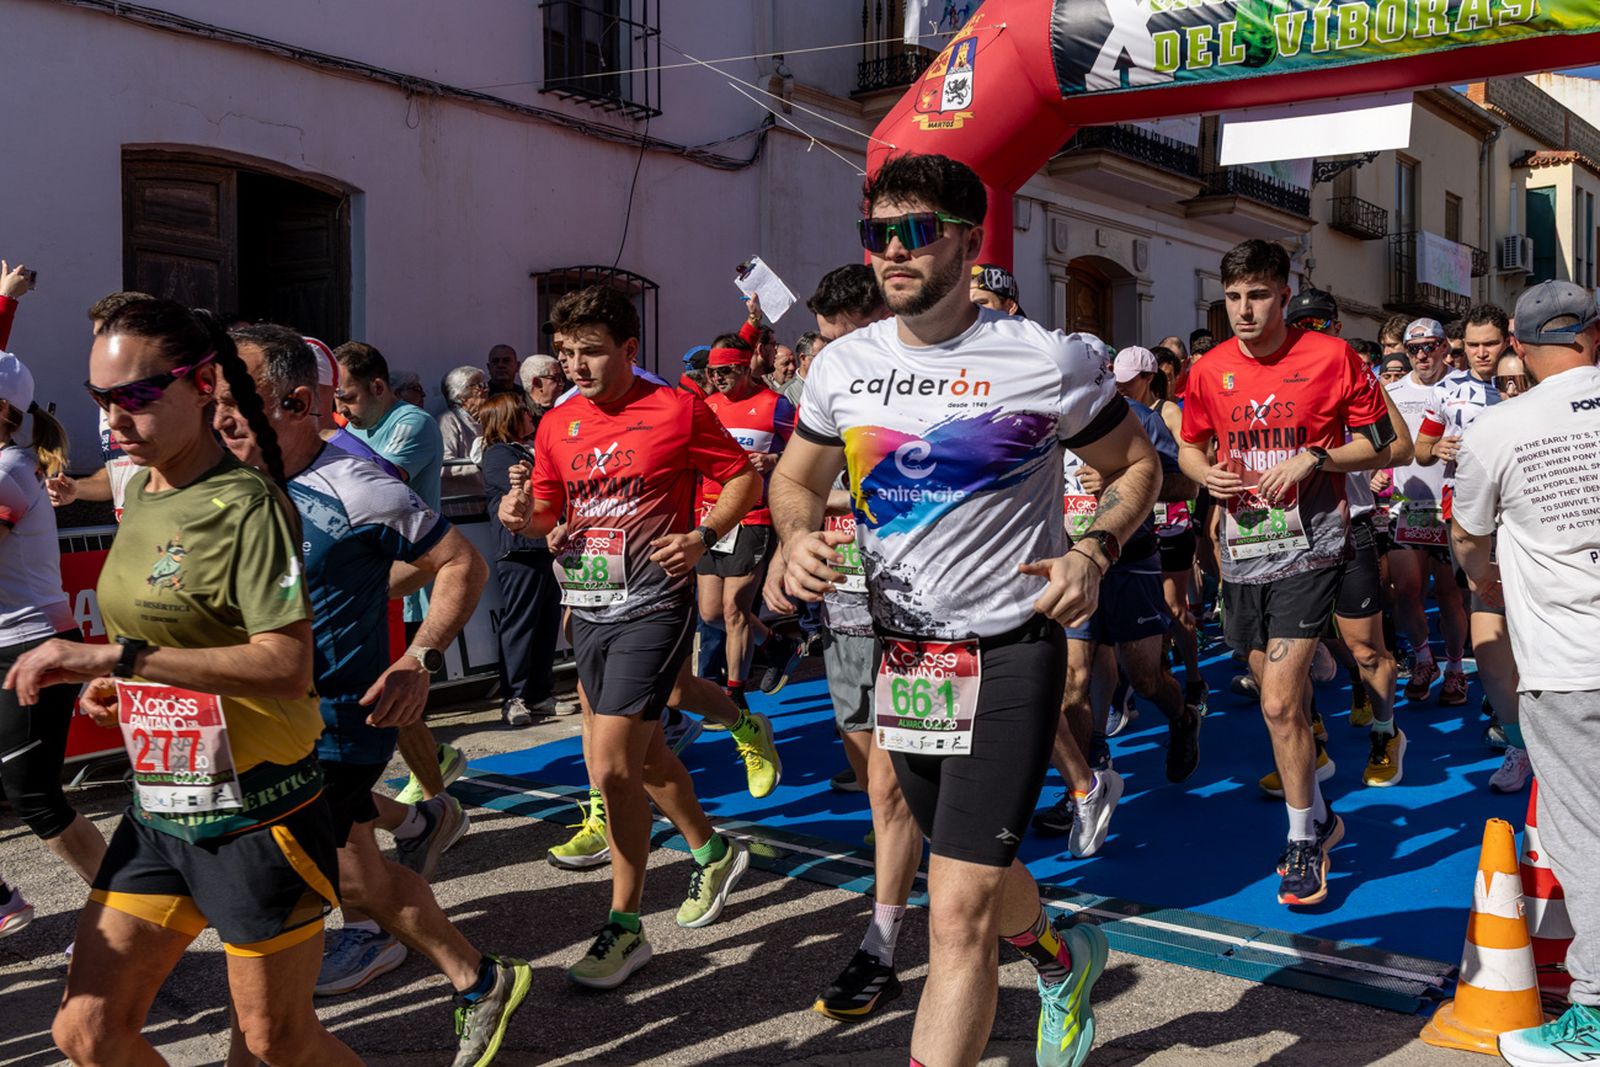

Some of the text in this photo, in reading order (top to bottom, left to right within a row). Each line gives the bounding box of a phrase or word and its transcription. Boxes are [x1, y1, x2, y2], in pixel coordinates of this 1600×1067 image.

[1152, 20, 1246, 73] DEL
[927, 121, 955, 129] MARTOS
[850, 368, 991, 406] calderón
[1231, 401, 1295, 422] CROSS
[1228, 426, 1308, 451] PANTANO
[1524, 440, 1541, 450] THE
[1542, 435, 1568, 446] EARLY
[571, 449, 635, 471] CROSS
[1517, 441, 1598, 464] BROKEN NEW YORK
[1545, 457, 1571, 468] WHEN
[1572, 452, 1597, 462] PONY
[1526, 473, 1548, 484] WITH
[1549, 465, 1590, 477] ORIGINAL
[877, 483, 965, 502] entrénate
[1523, 486, 1542, 496] REAL
[1579, 473, 1599, 483] NEW
[1068, 497, 1076, 509] X
[1531, 493, 1557, 505] BRAND
[1559, 488, 1582, 499] THEY
[1541, 505, 1553, 513] TO
[1554, 497, 1590, 510] SURVIVE
[1540, 515, 1561, 525] PONY
[1562, 511, 1580, 520] HAS
[1556, 525, 1567, 533] OF
[1577, 519, 1597, 529] CITY
[901, 652, 957, 668] CROSS
[885, 664, 945, 681] PANTANO
[127, 690, 199, 716] X CROSS
[891, 678, 953, 718] 661
[129, 714, 187, 731] PANTANO
[132, 727, 200, 772] 277
